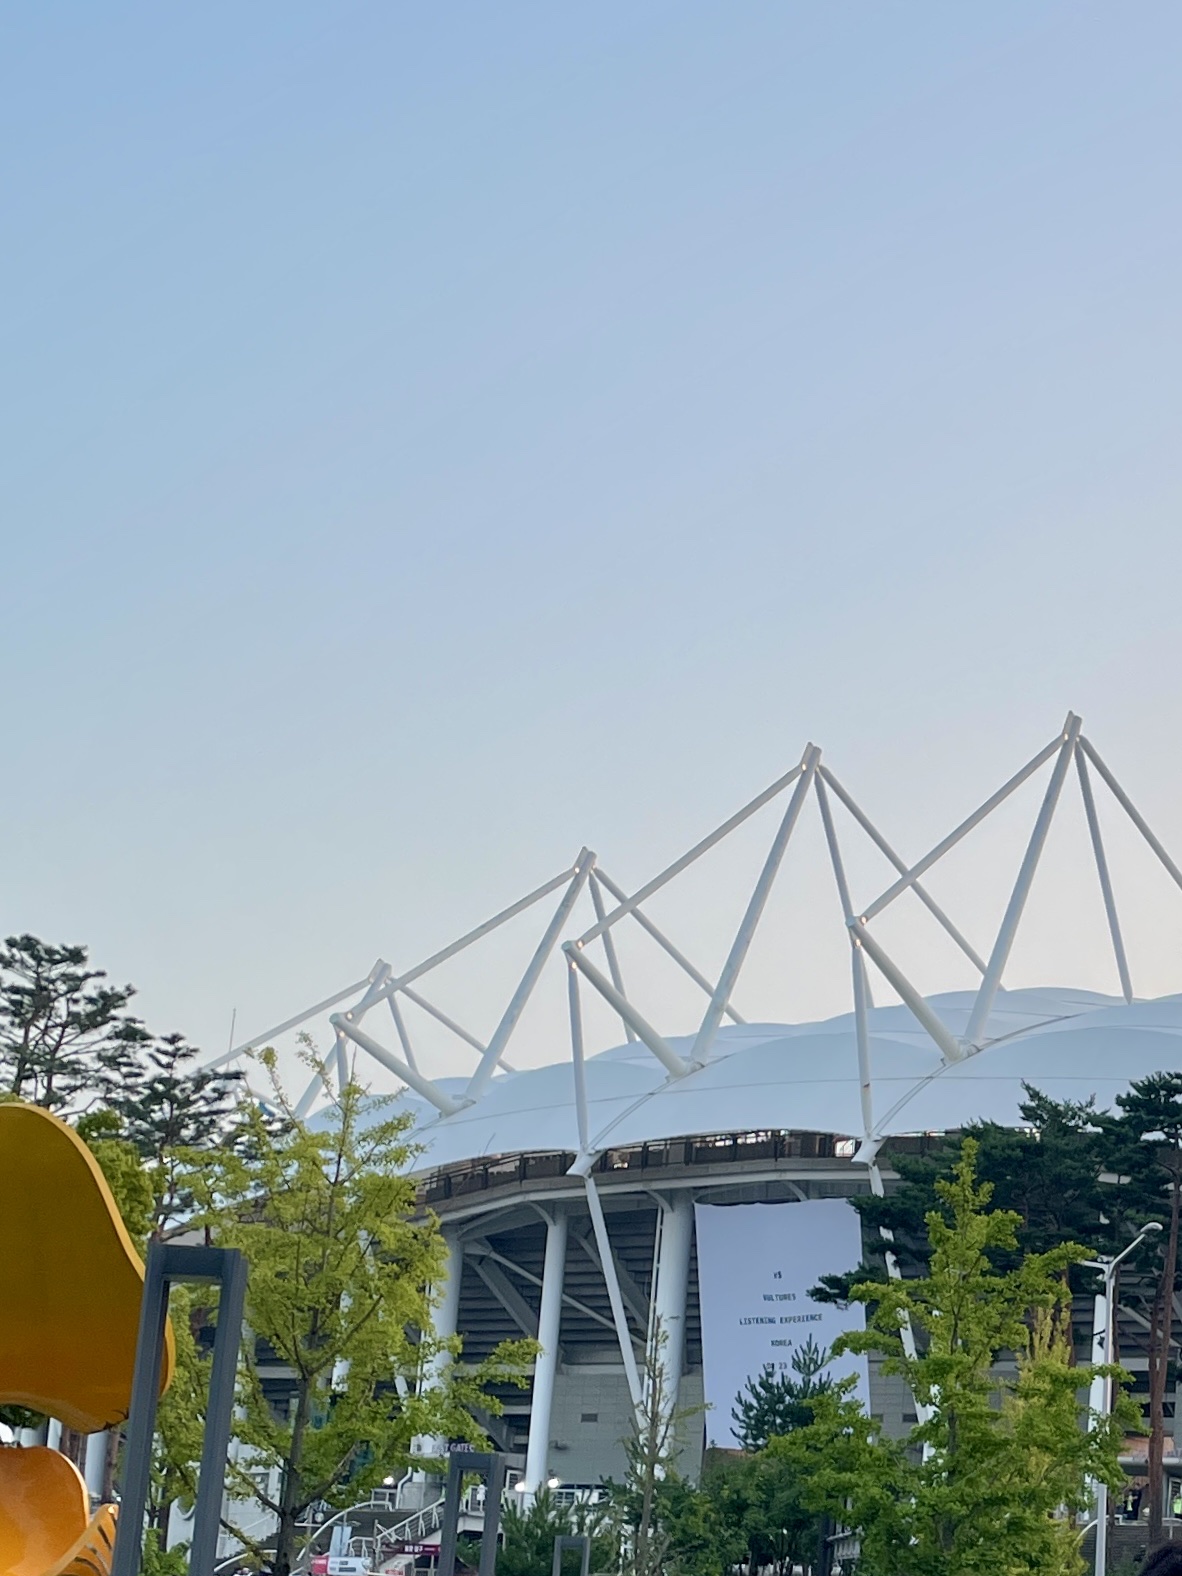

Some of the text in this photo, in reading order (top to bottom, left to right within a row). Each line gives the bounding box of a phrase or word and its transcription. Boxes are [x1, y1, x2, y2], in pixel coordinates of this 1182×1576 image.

[763, 1293, 796, 1301] VULTURES
[739, 1313, 822, 1325] LISTENING EXPERIENCE
